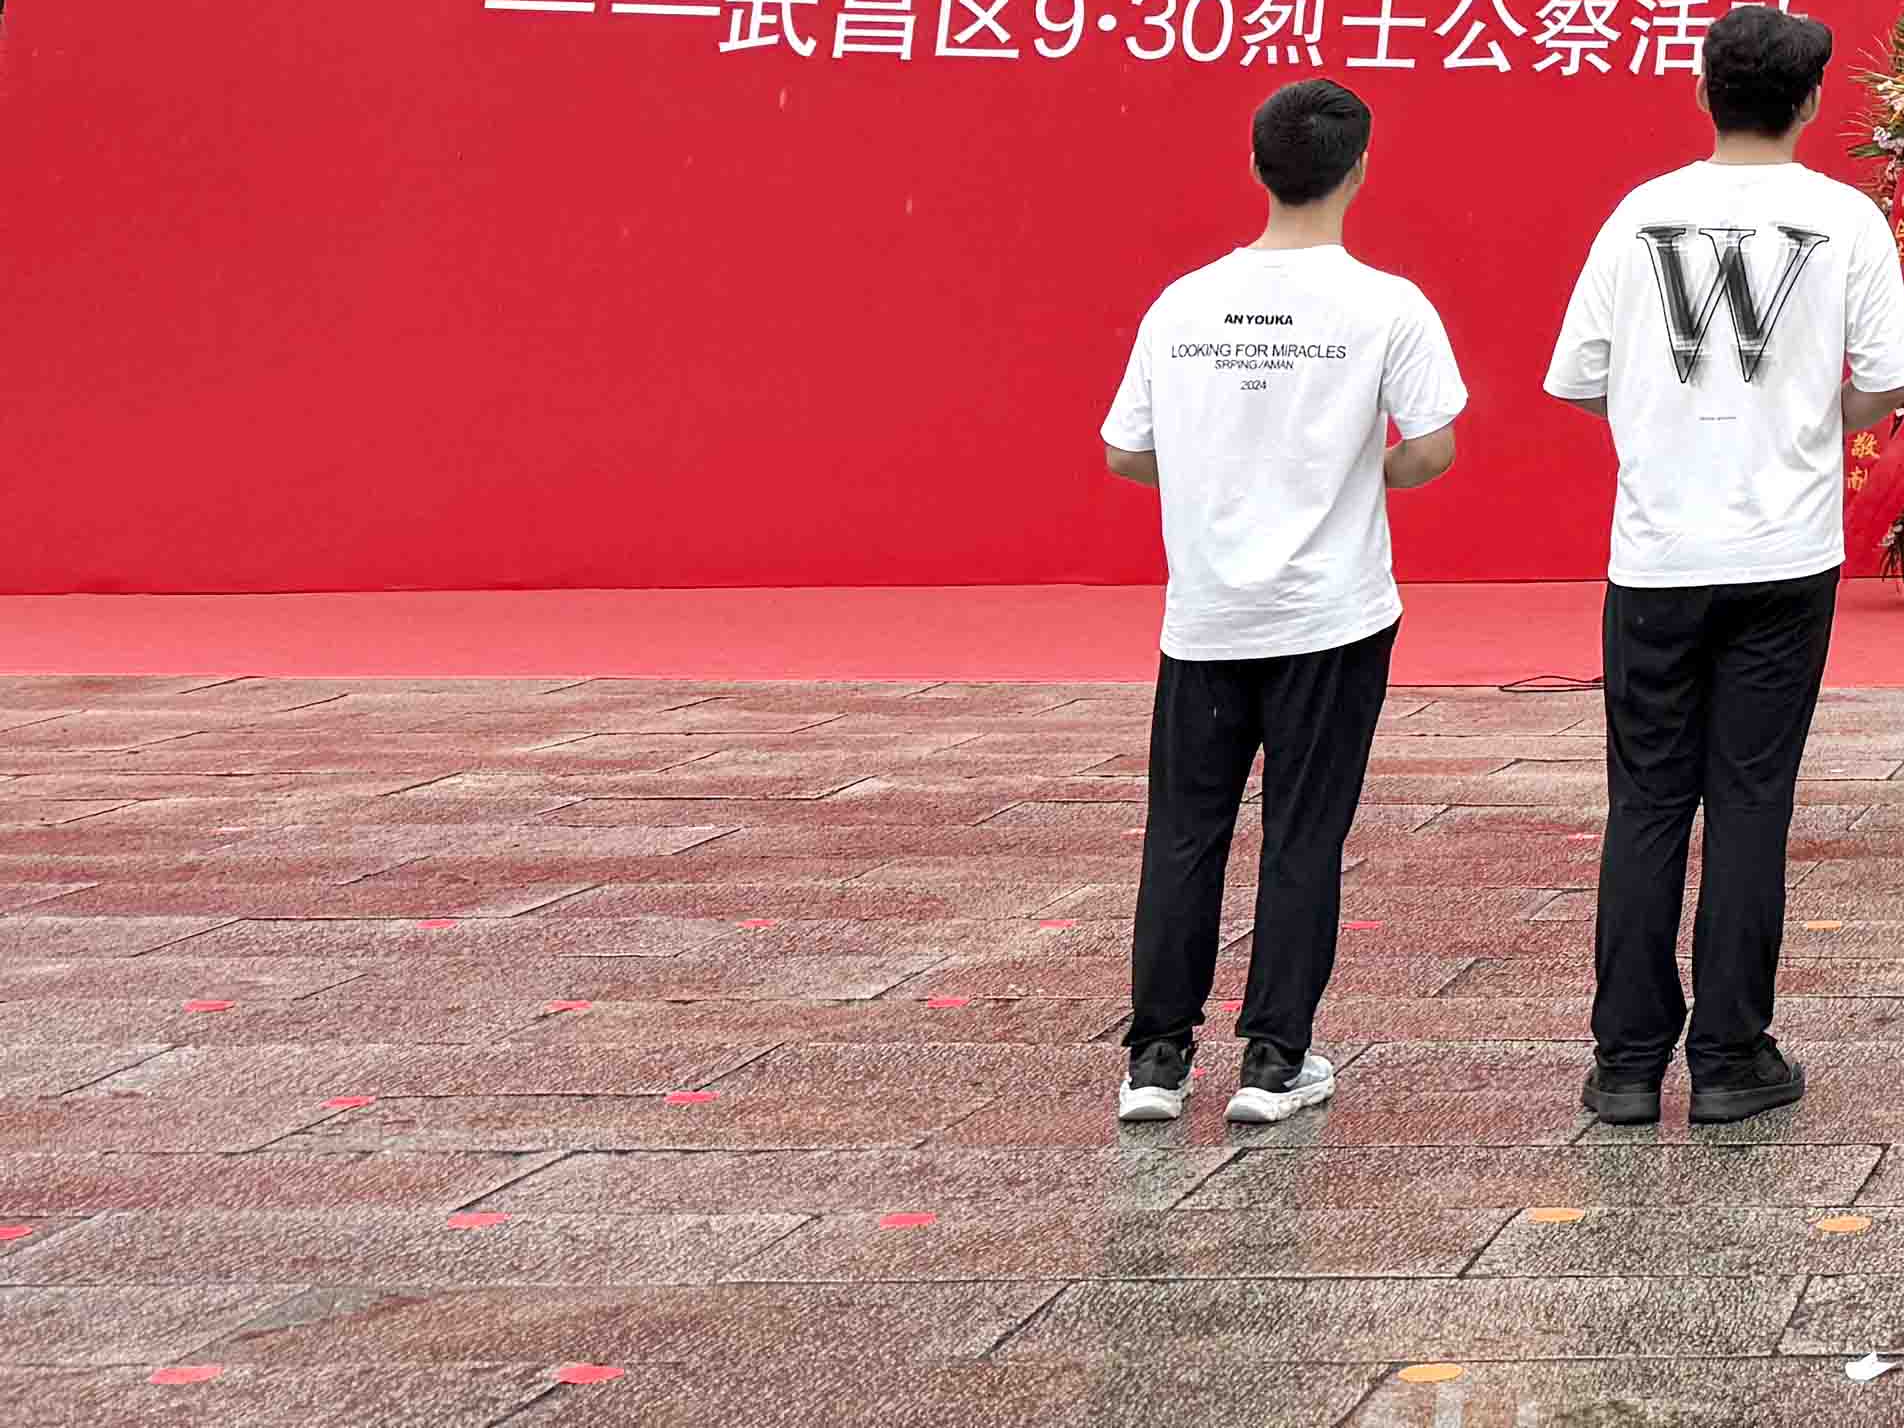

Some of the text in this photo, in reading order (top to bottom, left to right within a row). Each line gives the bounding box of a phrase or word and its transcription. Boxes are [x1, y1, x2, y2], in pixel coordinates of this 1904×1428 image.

[1635, 223, 1830, 384] W
[1171, 343, 1347, 359] LOOKING FOR MIRACLES
[1239, 380, 1268, 391] 2024
